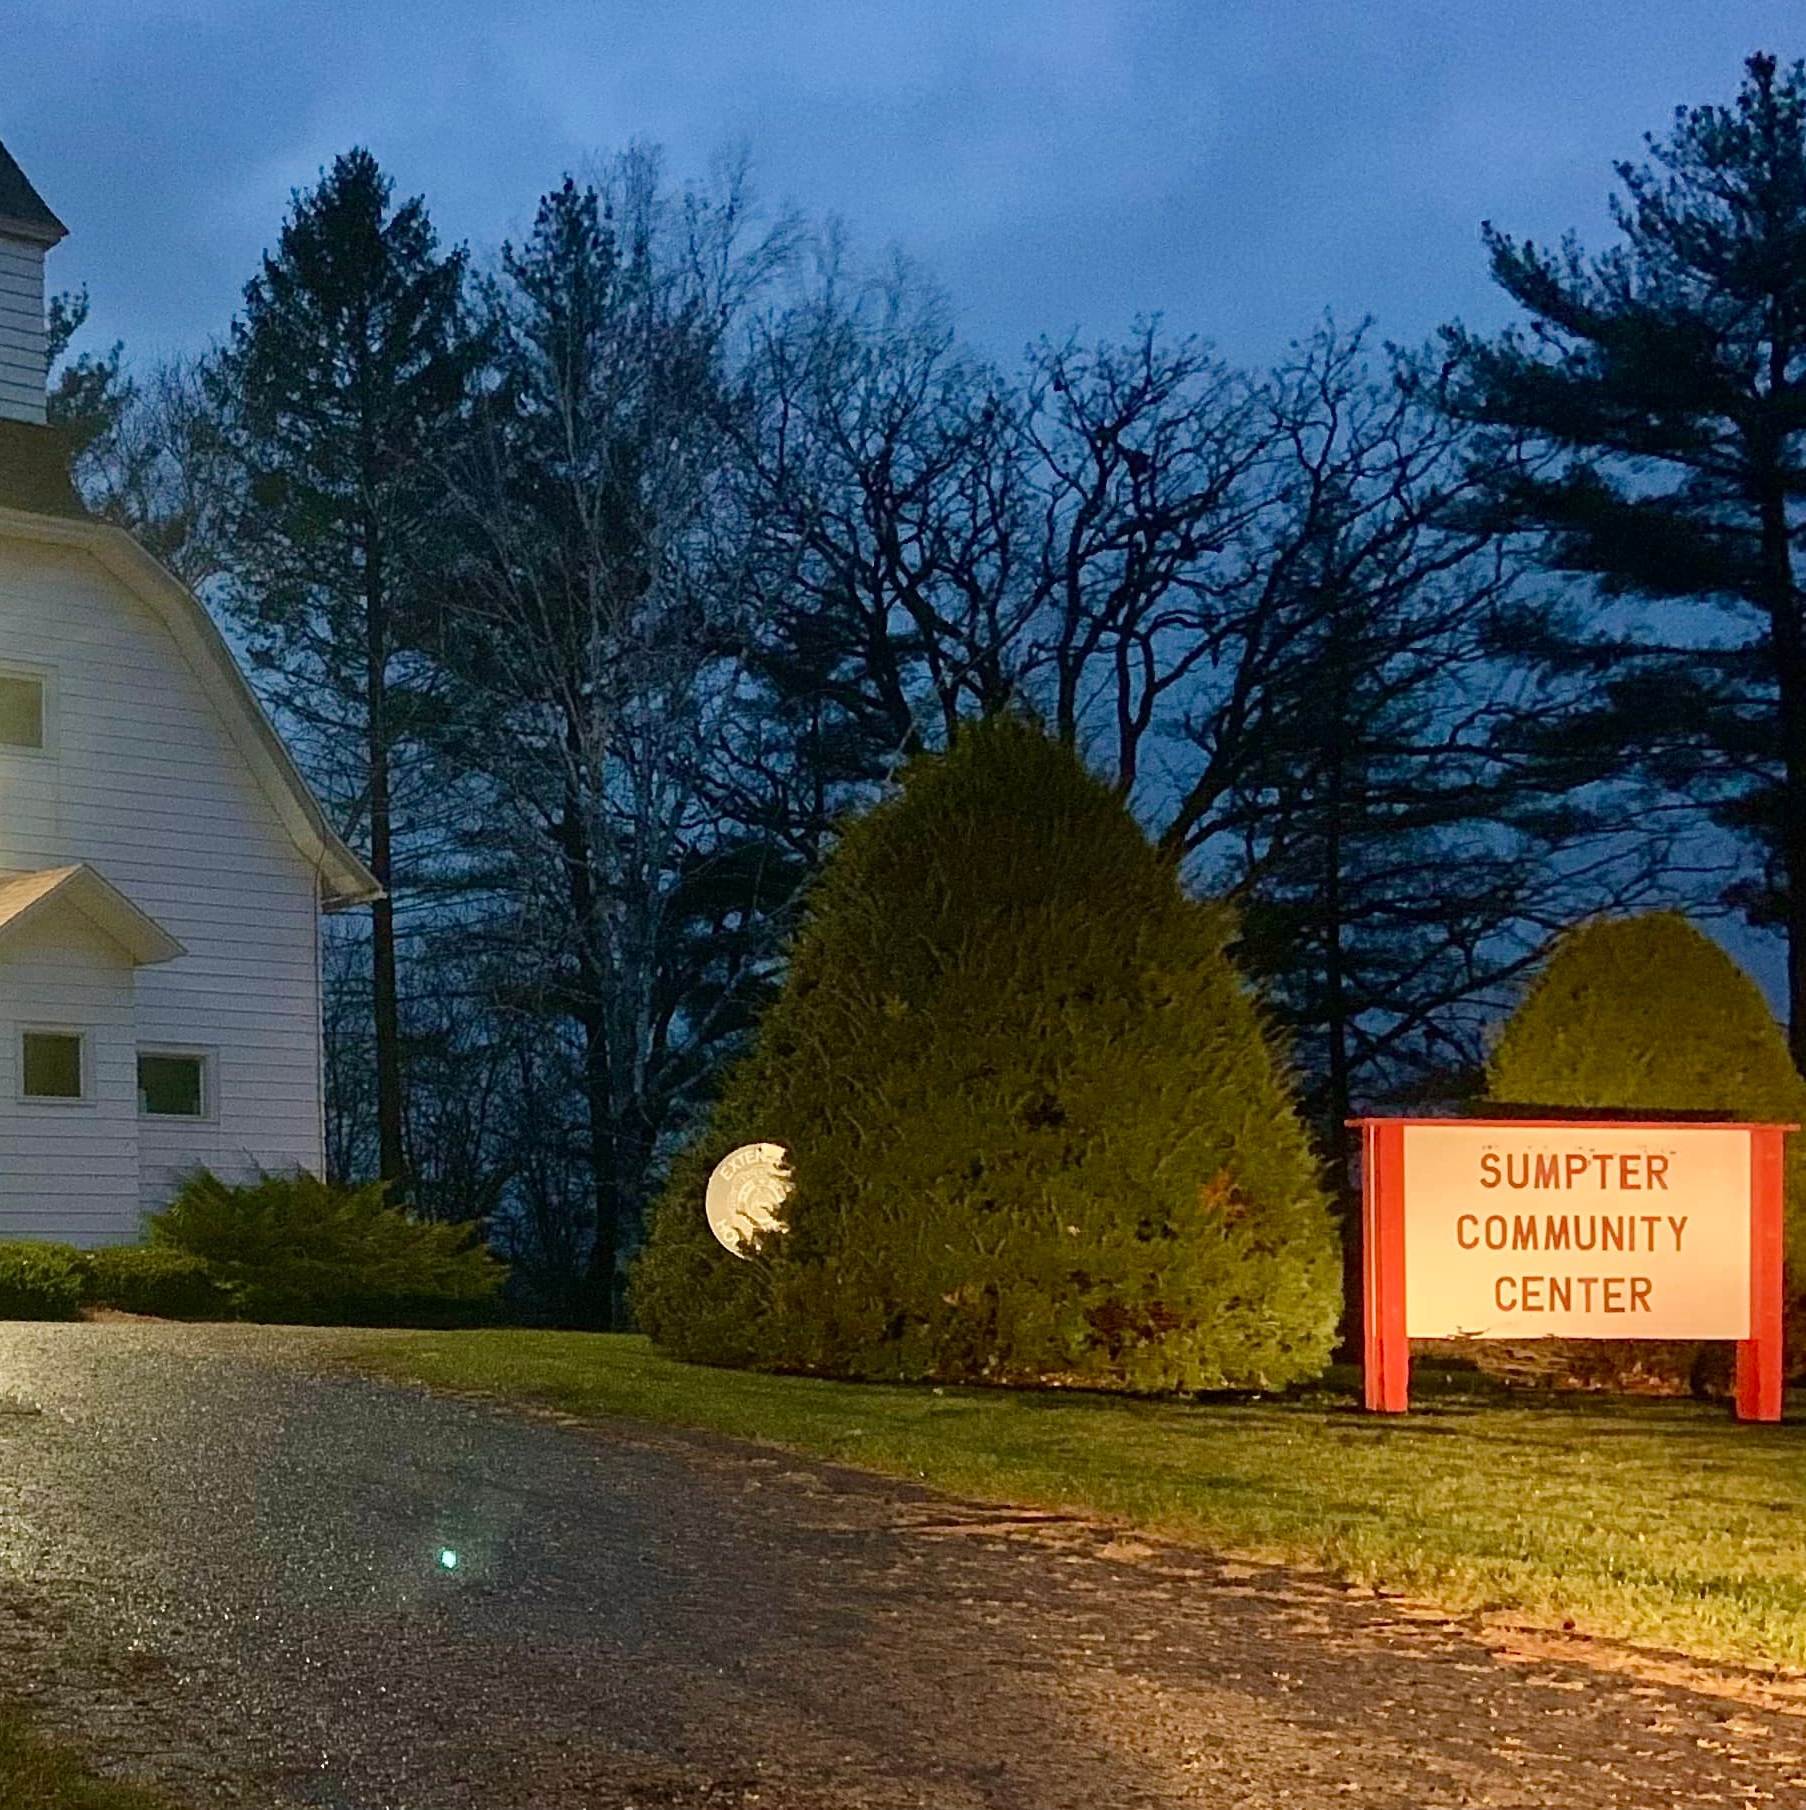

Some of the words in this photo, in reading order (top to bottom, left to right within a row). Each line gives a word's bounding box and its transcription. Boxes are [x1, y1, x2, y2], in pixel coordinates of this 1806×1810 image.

[1480, 1152, 1669, 1190] SUMPTER
[1457, 1213, 1688, 1252] COMMUNITY
[1495, 1275, 1652, 1313] CENTER
